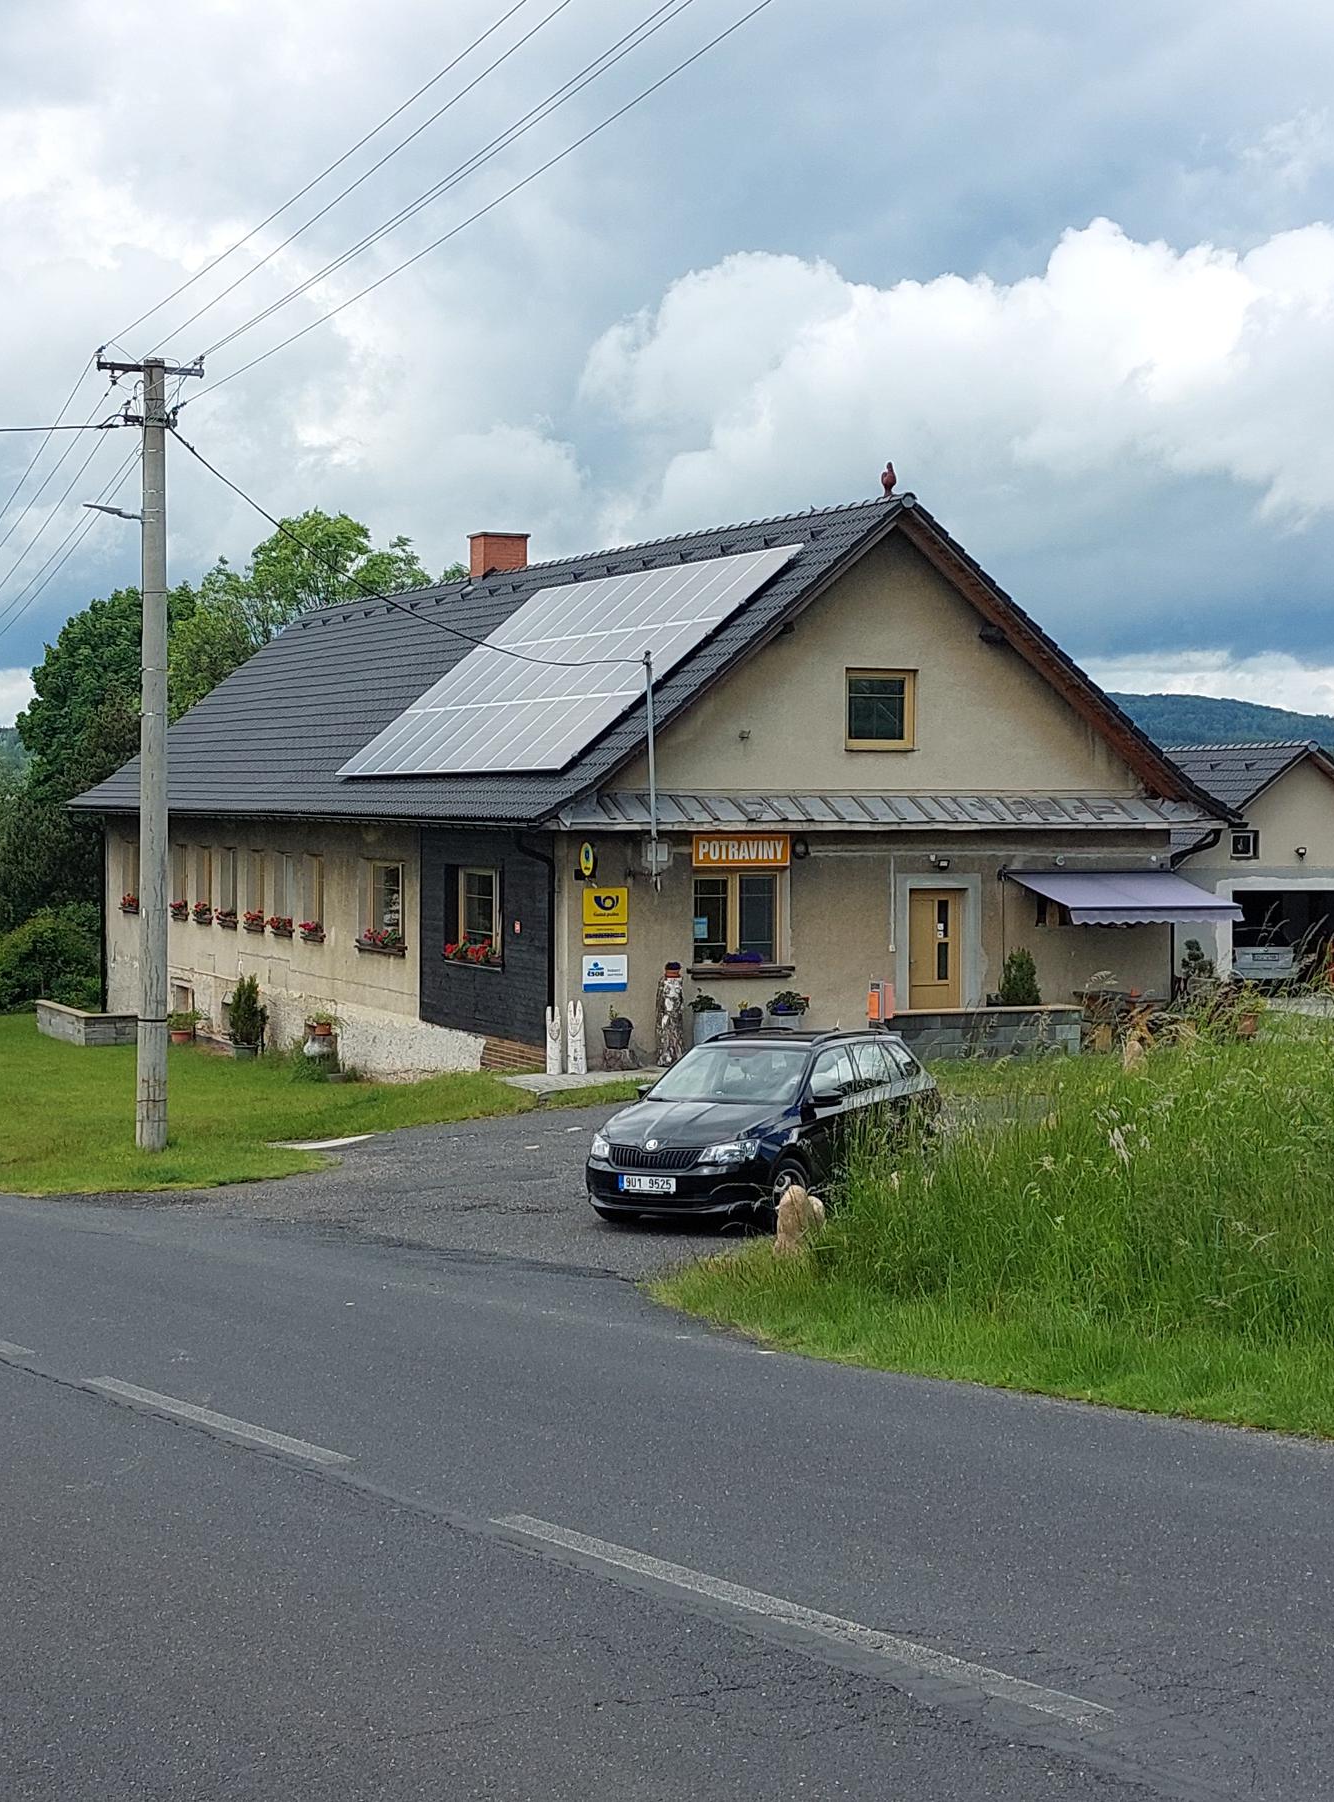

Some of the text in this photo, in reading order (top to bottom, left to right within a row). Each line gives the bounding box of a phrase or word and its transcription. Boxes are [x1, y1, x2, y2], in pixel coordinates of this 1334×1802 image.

[698, 840, 784, 861] POTRAVINY
[626, 1177, 672, 1190] 9U1 9525
